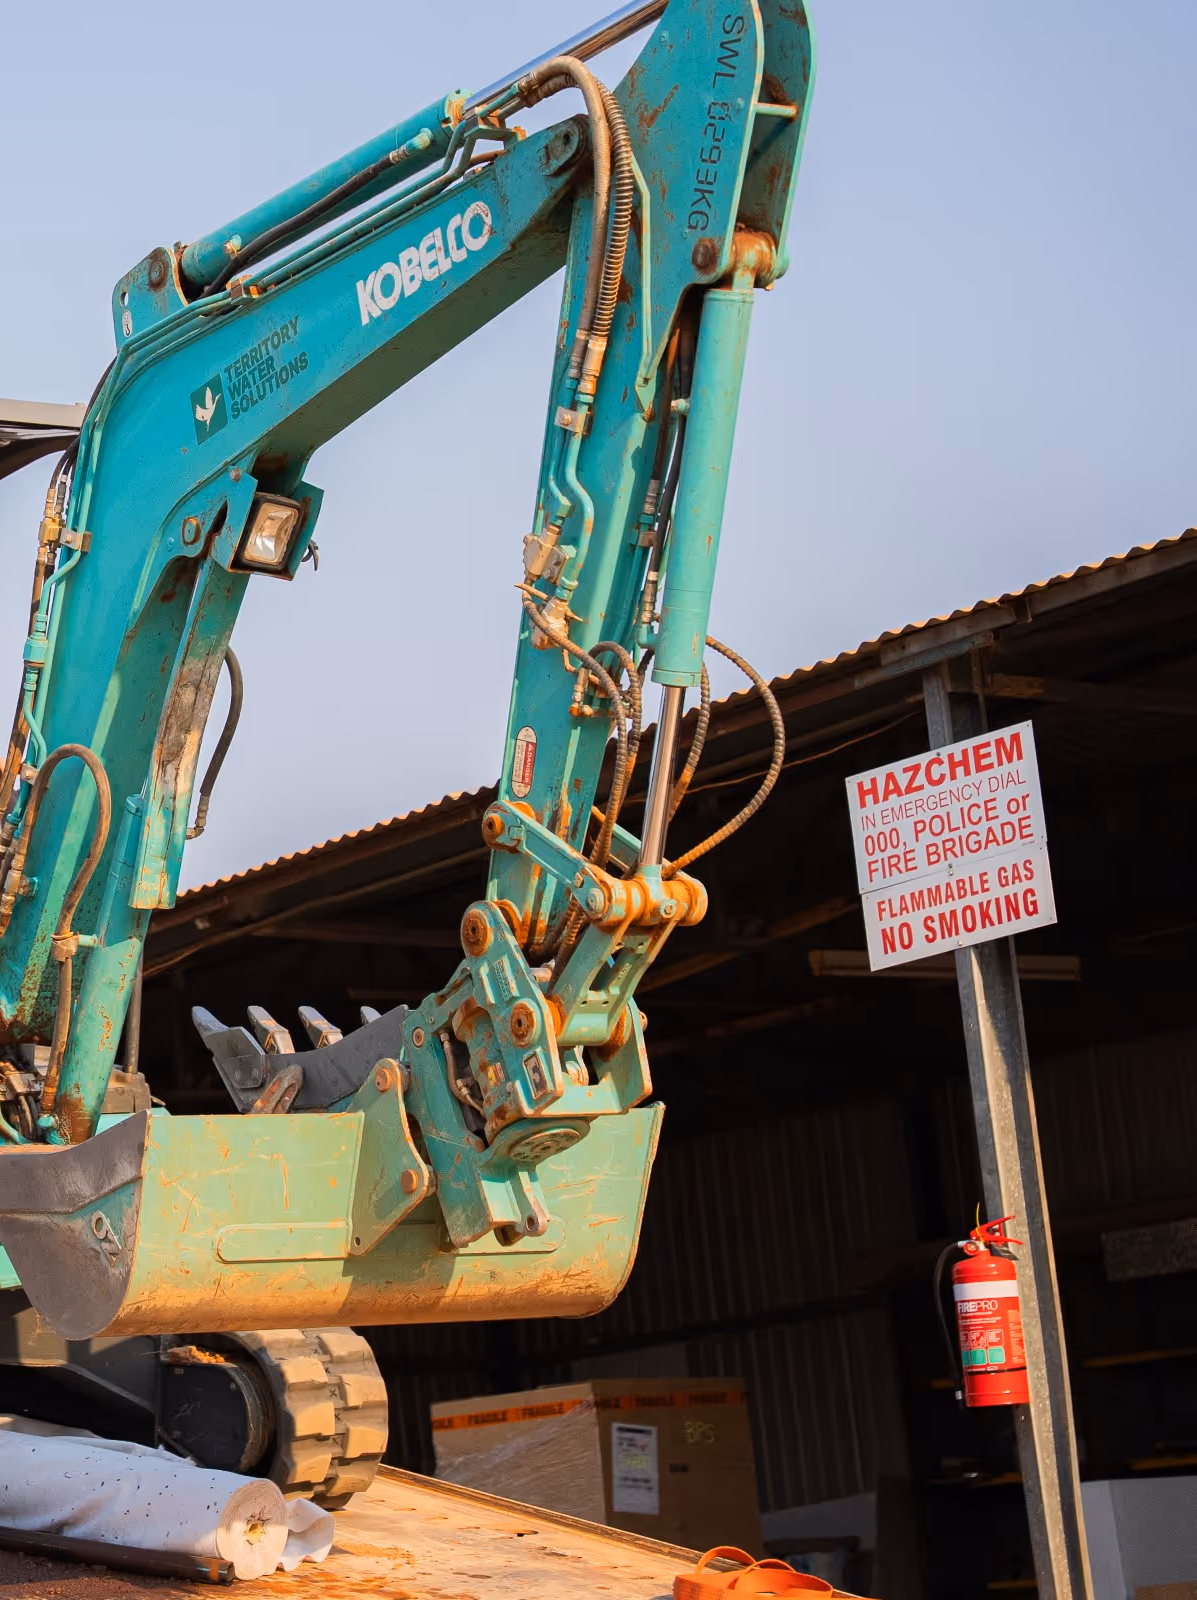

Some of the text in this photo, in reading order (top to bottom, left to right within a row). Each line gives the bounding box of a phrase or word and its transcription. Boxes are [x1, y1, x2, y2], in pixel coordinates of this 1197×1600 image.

[712, 14, 745, 89] SWL
[355, 201, 492, 326] KOBELCO
[224, 315, 299, 383] TERRITORY
[227, 355, 277, 401] WATER
[231, 351, 309, 420] SOLUTIONS
[524, 752, 533, 783] DANGER
[856, 732, 1024, 809] HAZCHEM
[861, 769, 1027, 831] IN EMERGENCY DIAL
[864, 793, 1030, 857] 000, POLICE or
[867, 816, 1034, 883] FIRE BRIGADE
[876, 859, 1035, 922] FLAMMABLE GAS
[881, 888, 1039, 955] NO SMOKING
[957, 1299, 998, 1312] FIREPRO
